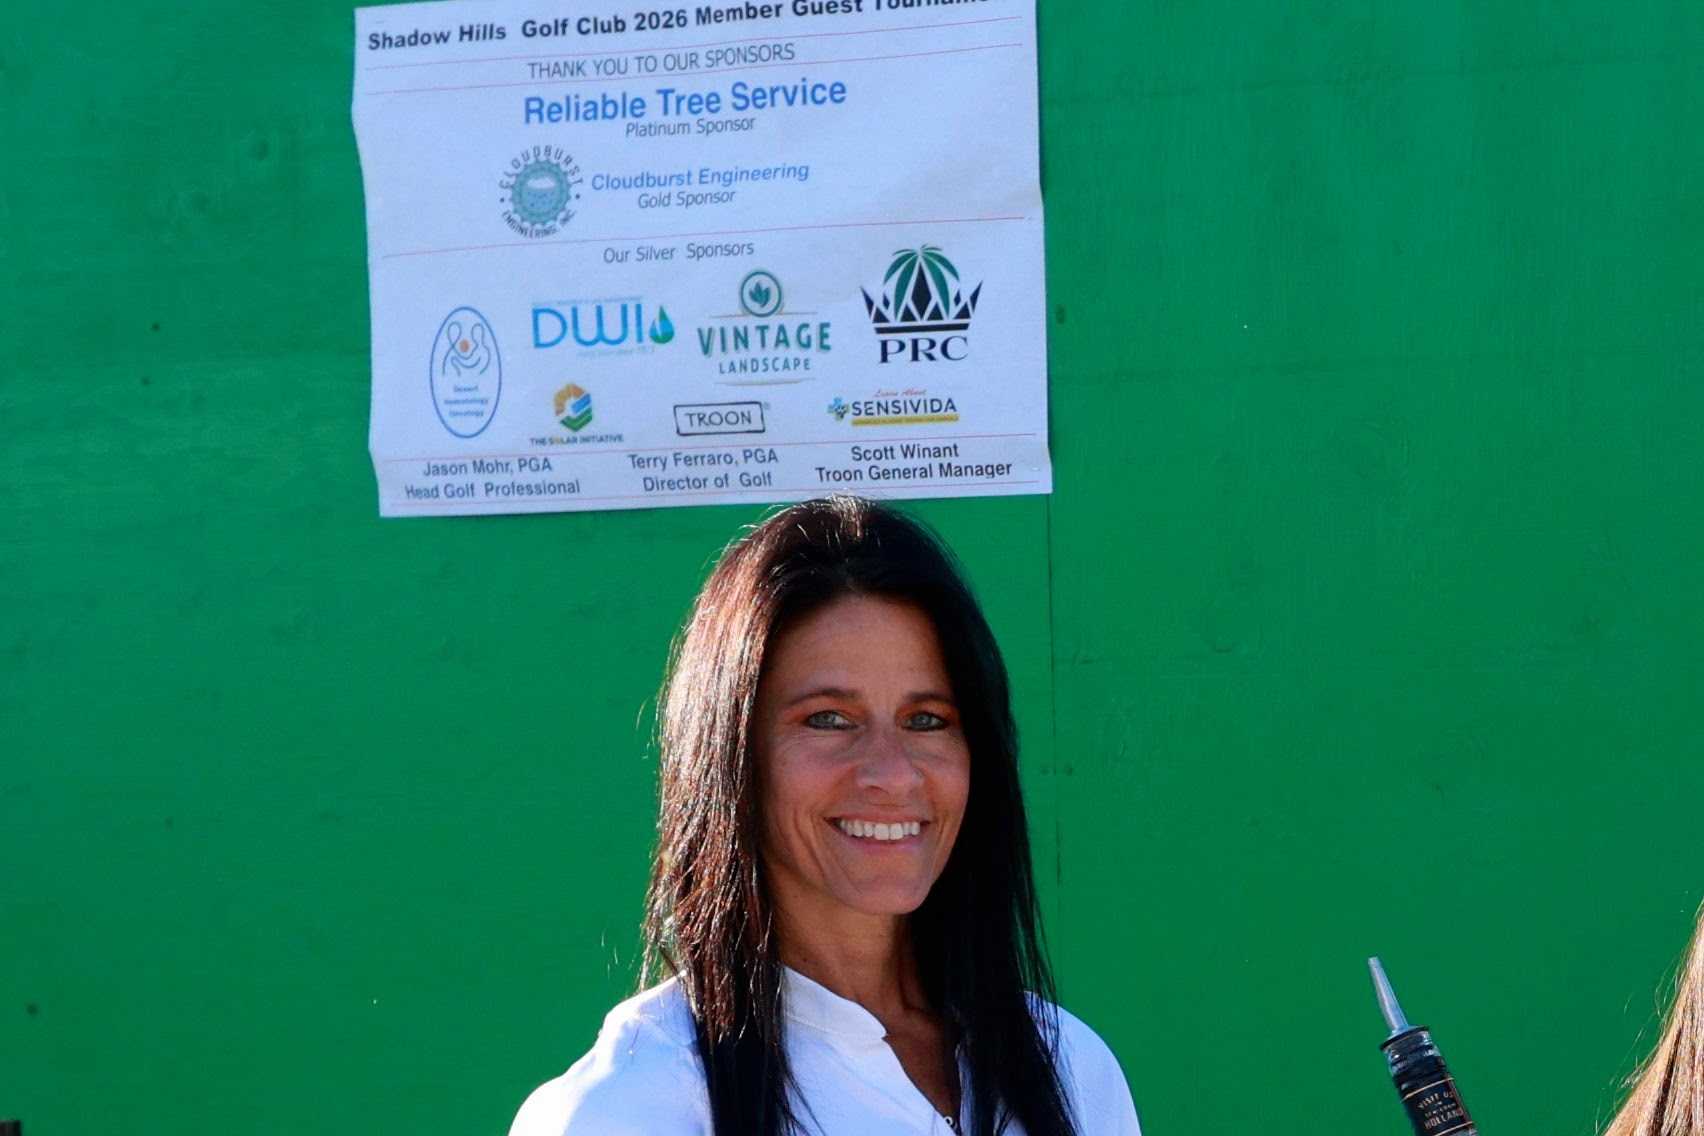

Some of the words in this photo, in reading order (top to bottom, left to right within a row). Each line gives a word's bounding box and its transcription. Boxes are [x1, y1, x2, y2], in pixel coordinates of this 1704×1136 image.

[368, 27, 452, 50] Shadow
[459, 23, 507, 43] Hills
[521, 18, 570, 38] Golf
[577, 14, 626, 36] Club
[634, 9, 688, 31] 2026
[695, 4, 781, 26] Member
[792, 0, 863, 16] Guest
[527, 59, 587, 80] THANK
[592, 56, 628, 77] YOU
[635, 55, 658, 73] TO
[663, 51, 701, 70] OUR
[704, 43, 796, 69] SPONSORS
[524, 91, 647, 125] Reliable
[656, 86, 721, 116] Tree
[731, 77, 847, 111] Service
[625, 122, 690, 138] Platinum
[696, 116, 756, 136] Sponsor
[591, 171, 693, 191] Cloudburst
[699, 162, 810, 187] Engineering
[637, 191, 672, 209] Gold
[676, 189, 736, 209] Sponsor
[603, 247, 631, 264] Our
[636, 245, 677, 262] Silver
[686, 241, 755, 260] Sponsors
[697, 321, 832, 357] VINTAGE
[877, 335, 969, 364] PRC
[719, 357, 811, 375] LANDSCAPE
[685, 409, 753, 427] TROON
[851, 398, 957, 416] SENSIVIDA
[530, 438, 547, 446] THE
[580, 433, 624, 444] INITIATIVE
[627, 453, 668, 472] Terry
[672, 450, 739, 469] Ferraro,
[743, 448, 779, 464] PGA
[851, 446, 895, 462] Scott
[900, 443, 959, 460] Winant
[423, 460, 468, 477] Jason
[472, 458, 514, 477] Mohr,
[518, 457, 553, 473] PGA
[815, 465, 863, 483] Troon
[869, 463, 933, 481] General
[938, 460, 1013, 480] Manager
[405, 484, 439, 500] Head
[443, 482, 476, 499] Golf
[484, 479, 581, 498] Professional
[643, 475, 707, 492] Director
[713, 472, 730, 489] of
[740, 471, 772, 488] Golf
